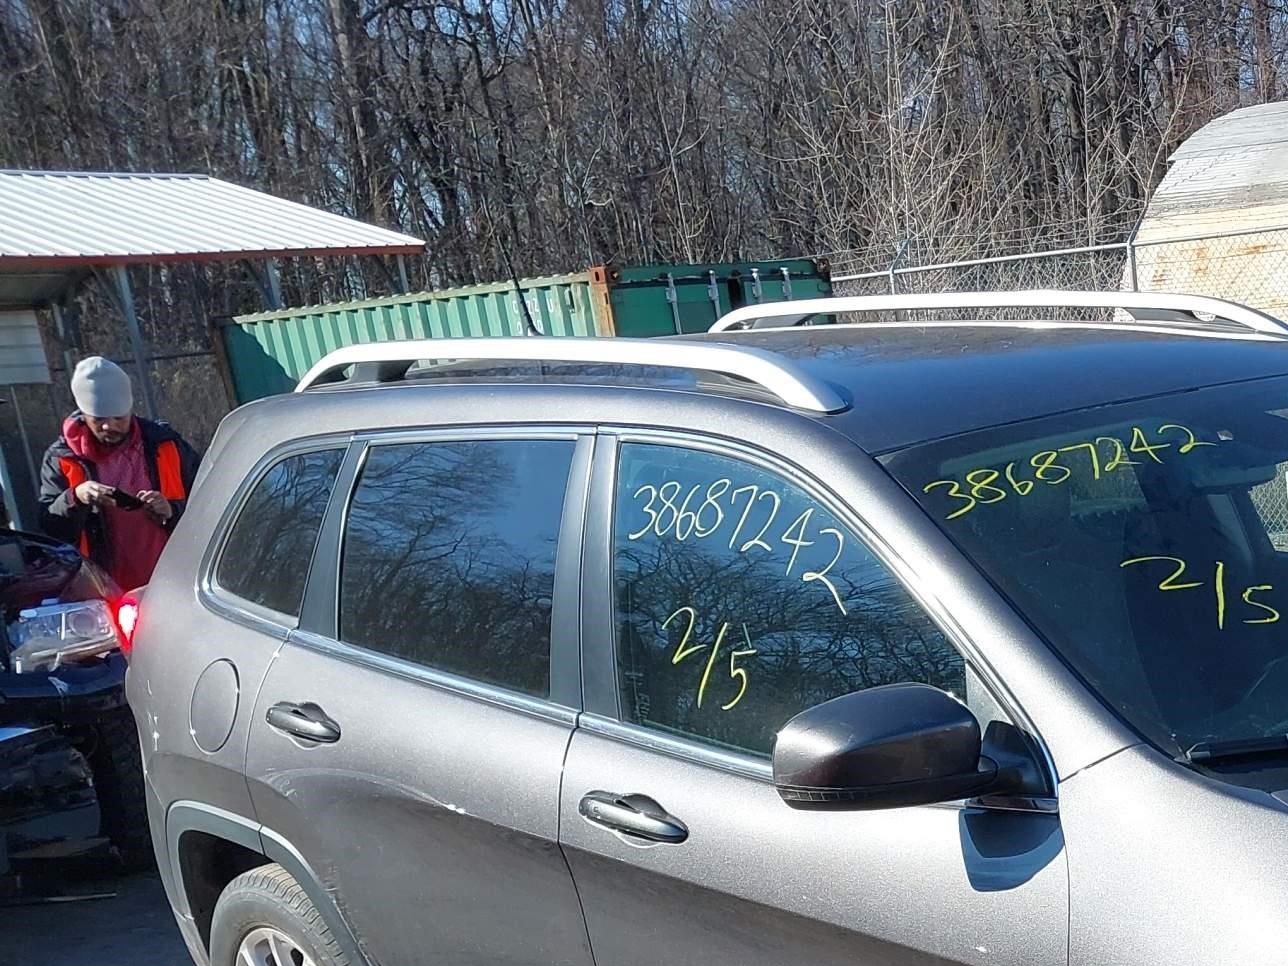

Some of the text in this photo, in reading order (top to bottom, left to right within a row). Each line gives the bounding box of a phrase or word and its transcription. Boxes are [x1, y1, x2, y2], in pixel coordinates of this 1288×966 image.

[923, 424, 1217, 519] 38687242
[628, 478, 848, 615] 38687242
[661, 607, 757, 711] 2/5
